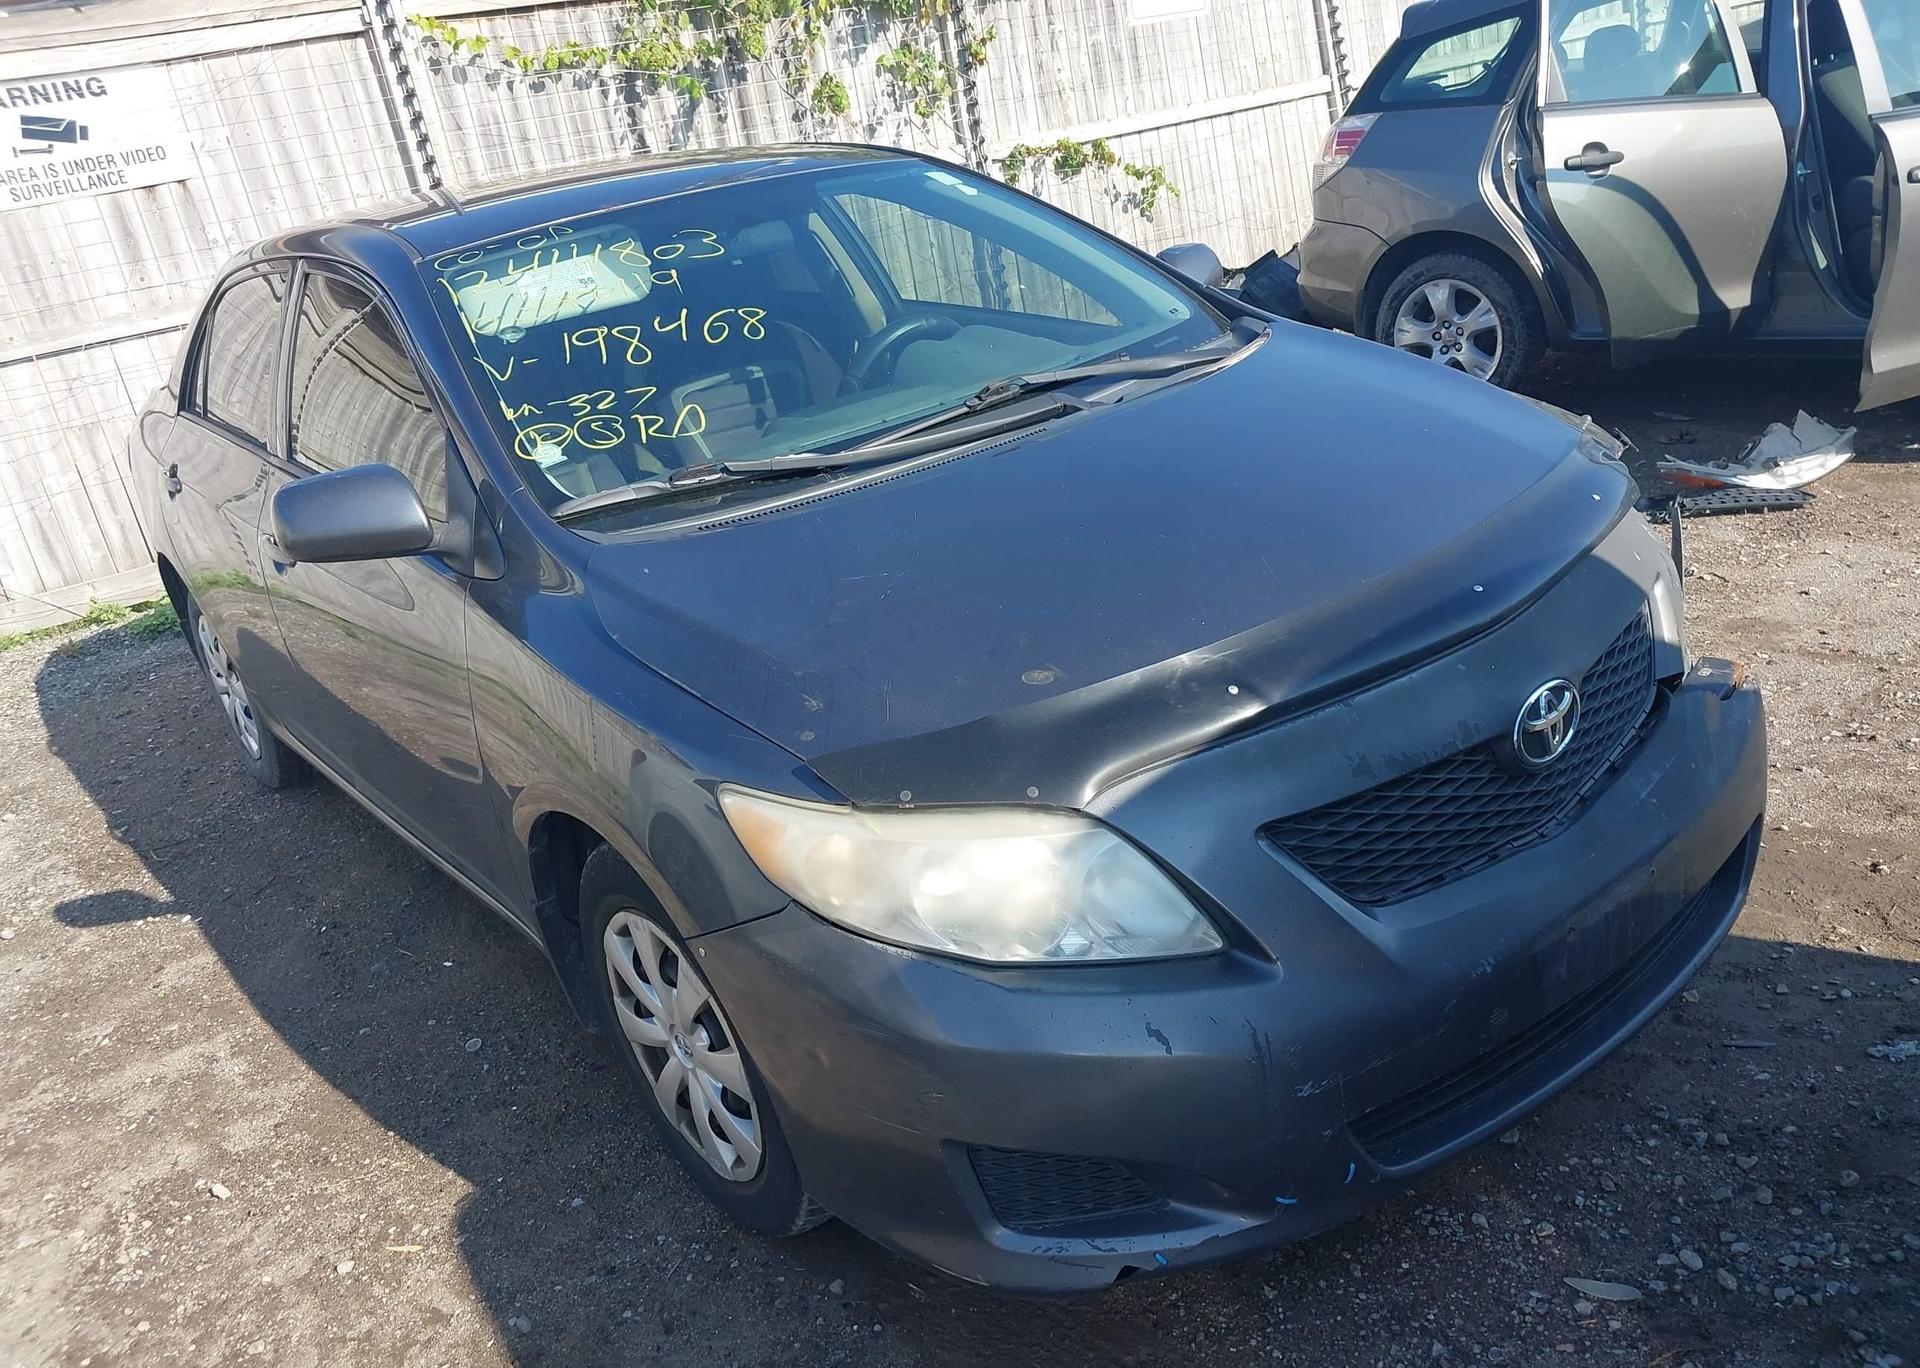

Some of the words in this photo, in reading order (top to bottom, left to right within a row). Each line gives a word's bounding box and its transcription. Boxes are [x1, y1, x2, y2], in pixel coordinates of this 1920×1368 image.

[45, 162, 60, 180] IS
[62, 154, 117, 176] UNDER
[120, 145, 167, 166] VIDEO
[9, 169, 128, 202] SURVEILLANCE
